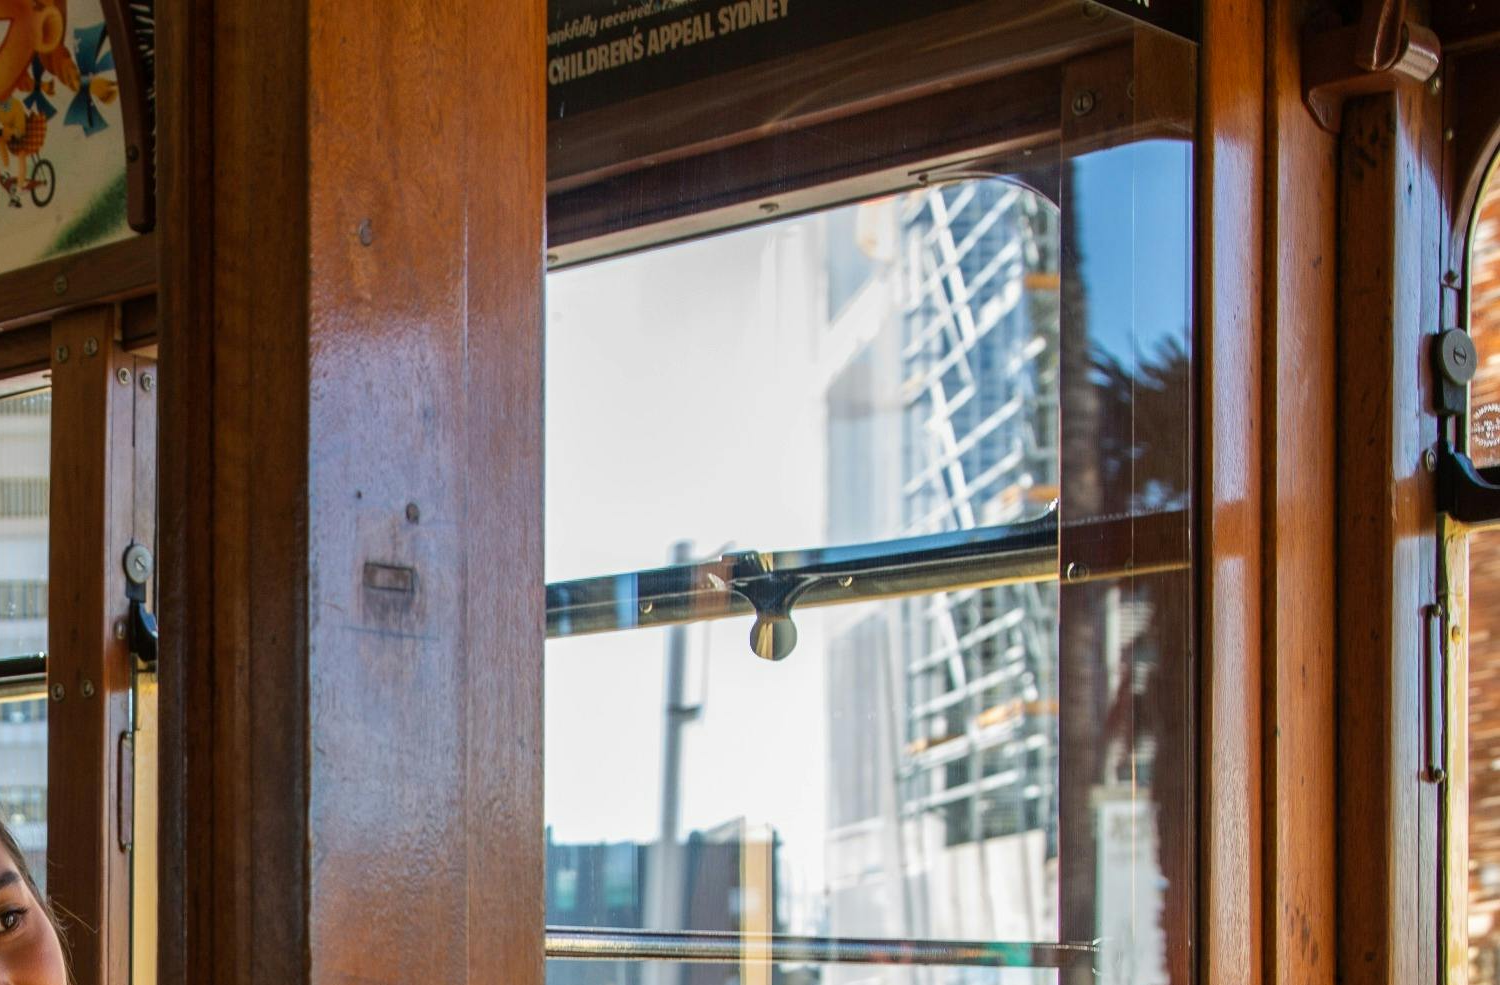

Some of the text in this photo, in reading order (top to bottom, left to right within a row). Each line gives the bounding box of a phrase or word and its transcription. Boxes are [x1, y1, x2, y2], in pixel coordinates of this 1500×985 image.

[549, 0, 790, 86] CHILDREN'S APPEAL SYDNEY
